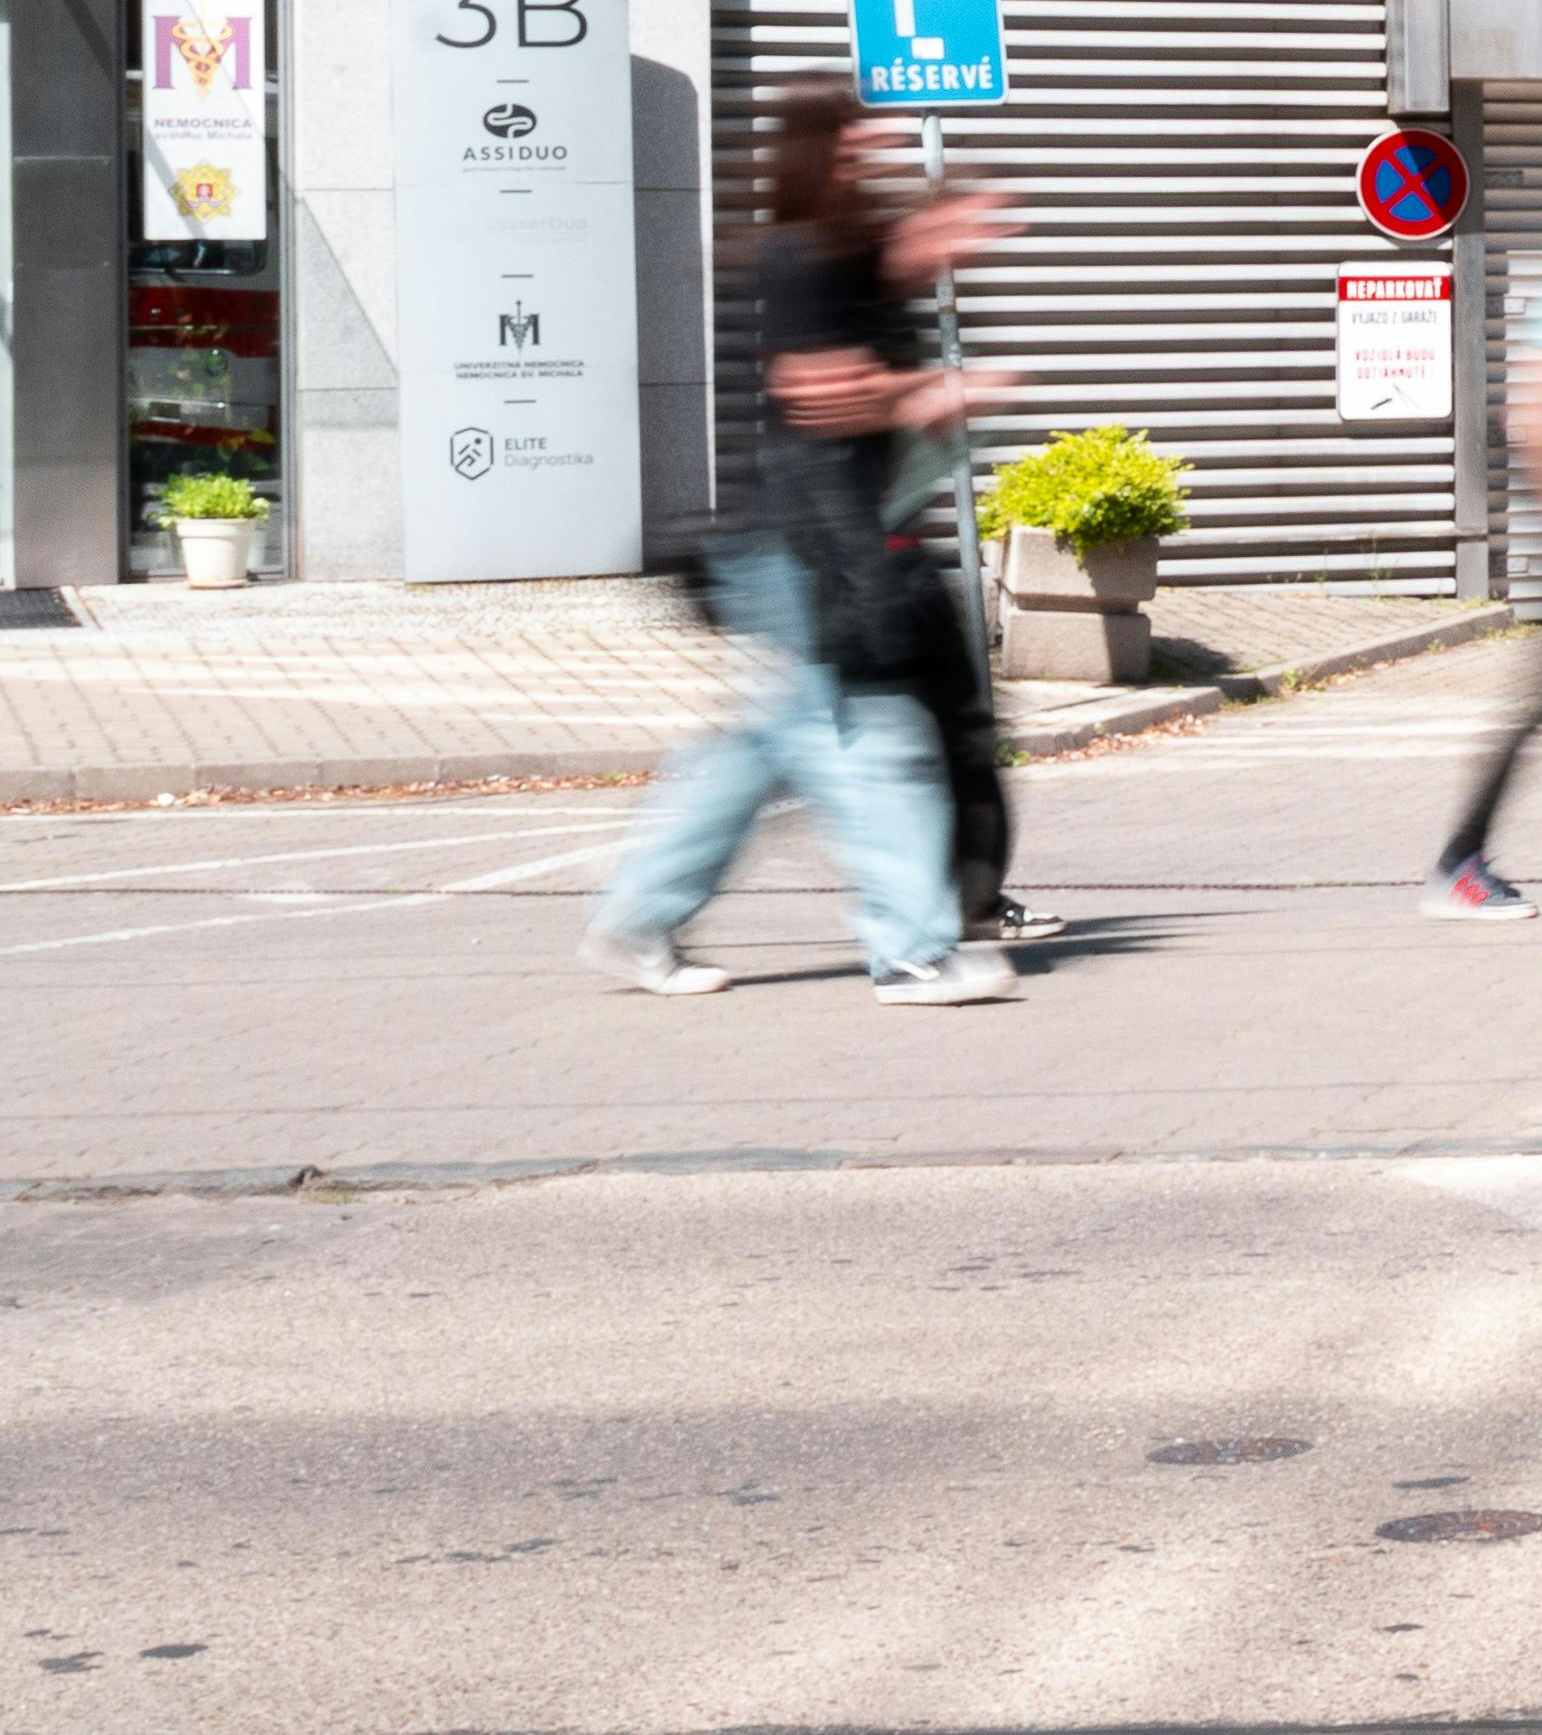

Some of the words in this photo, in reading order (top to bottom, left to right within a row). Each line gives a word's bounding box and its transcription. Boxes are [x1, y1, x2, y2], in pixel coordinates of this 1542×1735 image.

[870, 55, 994, 92] RÉSERVÉ
[153, 118, 252, 128] NEMOCNICA
[463, 145, 568, 161] ASSIDUO
[1346, 277, 1443, 299] NEPARKOVAŤ
[504, 437, 548, 451] ELITE
[504, 452, 594, 471] Diagnostika
